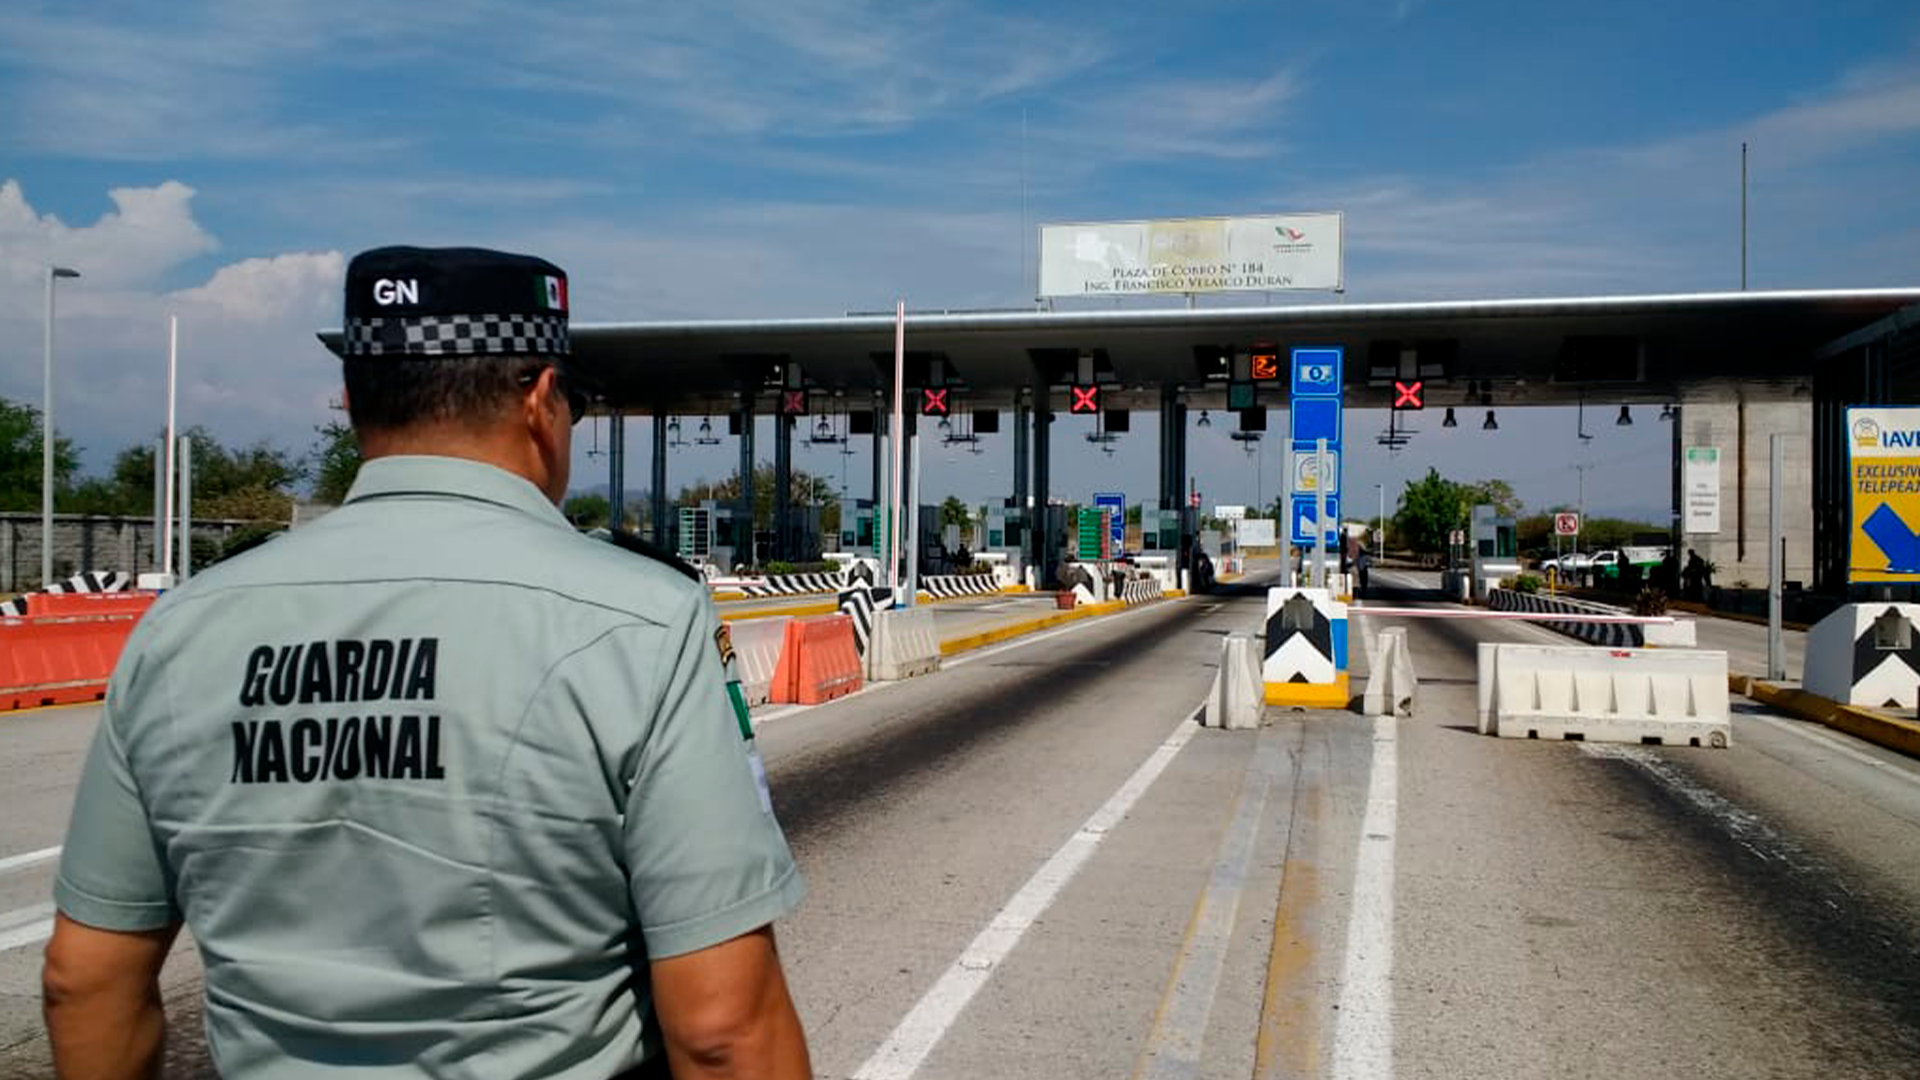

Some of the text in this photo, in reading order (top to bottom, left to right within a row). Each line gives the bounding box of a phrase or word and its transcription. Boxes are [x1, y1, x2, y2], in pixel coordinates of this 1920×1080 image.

[1112, 266, 1149, 279] PLAZA
[1152, 266, 1168, 278] DE
[1171, 264, 1216, 276] COBRO
[1242, 261, 1264, 273] 184
[1114, 278, 1184, 291] FRANCISCO
[1187, 276, 1243, 289] VELASCO
[373, 278, 419, 306] GN
[240, 638, 438, 707] GUARDIA
[231, 715, 445, 784] NACIONAL
